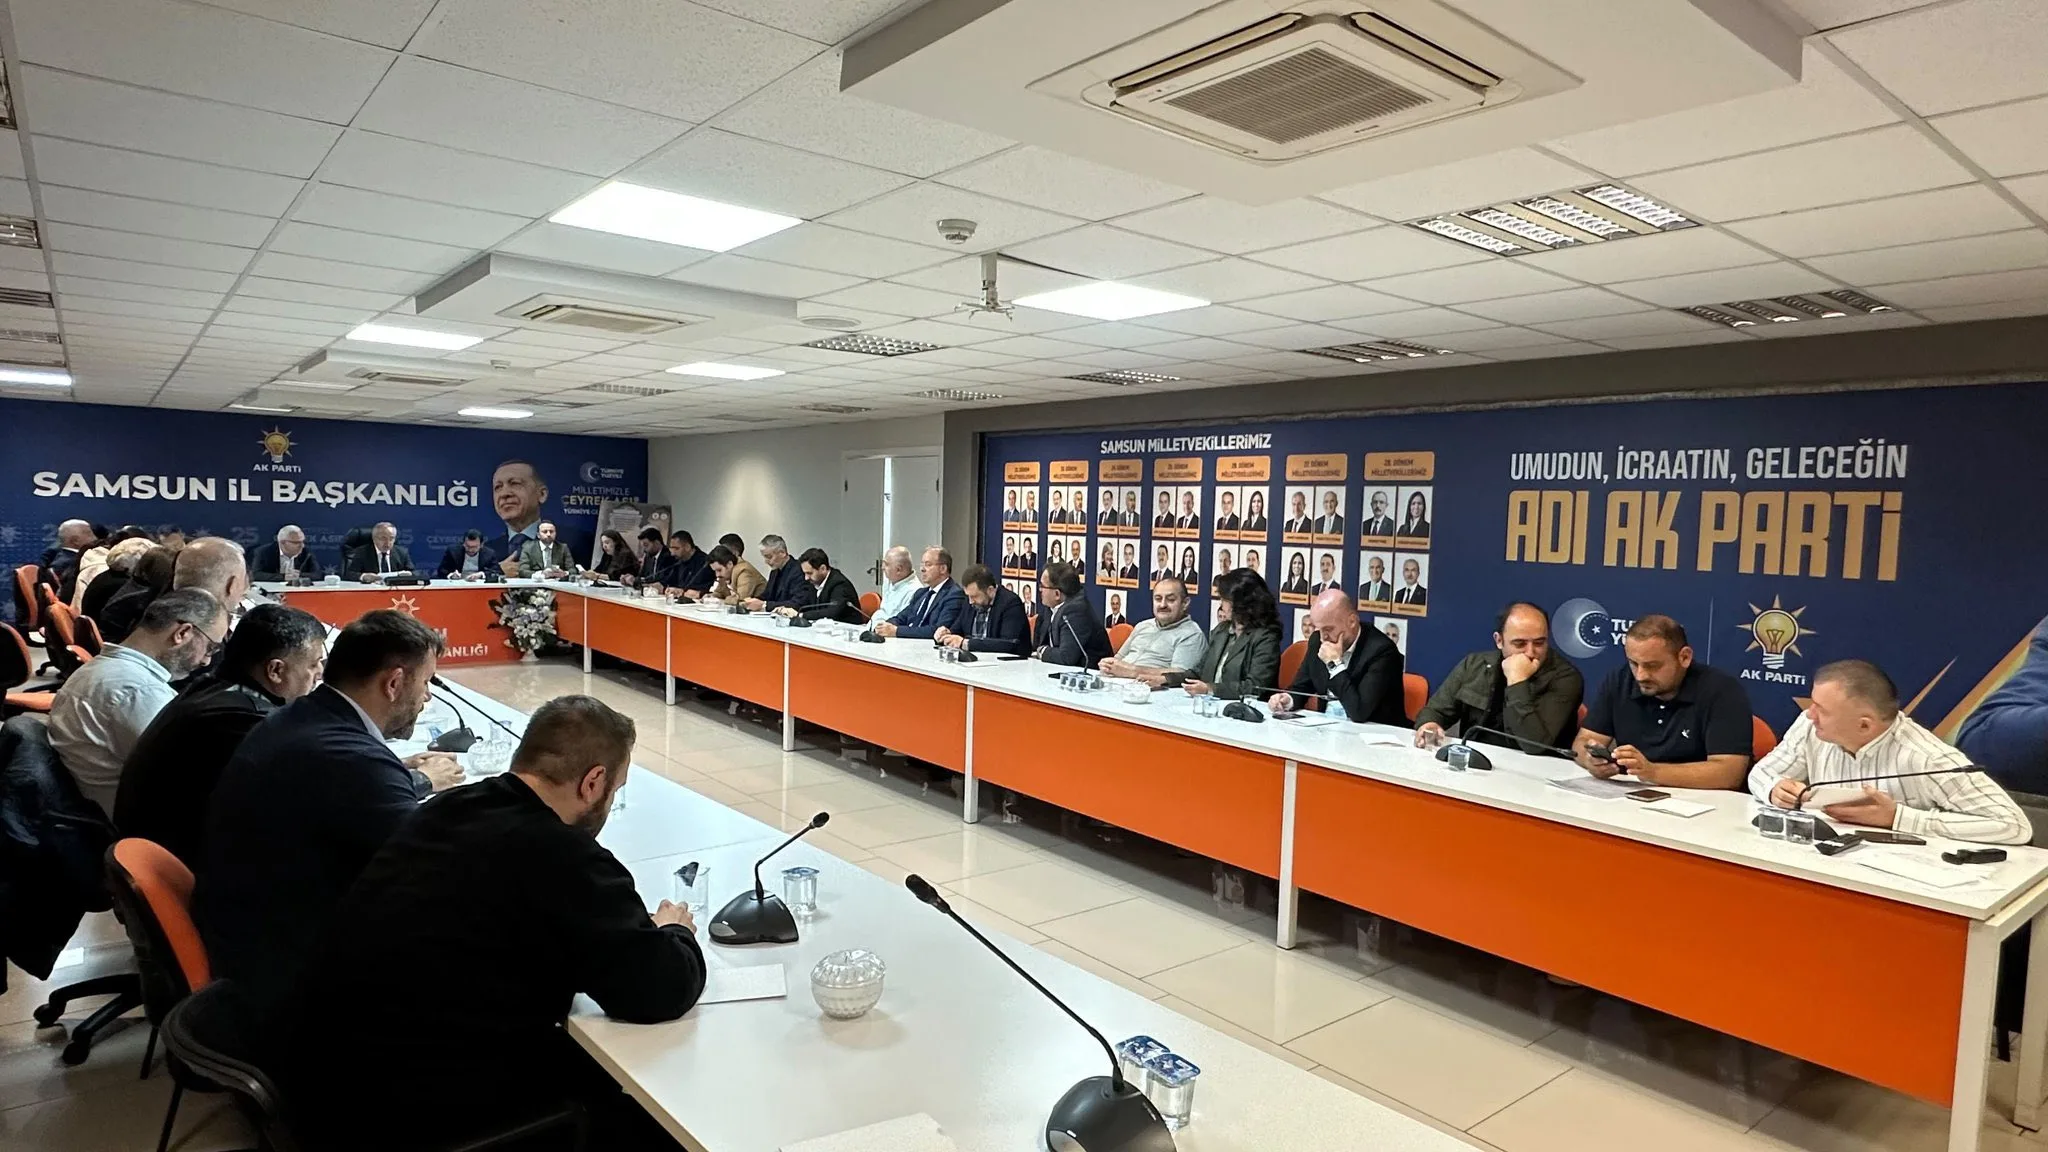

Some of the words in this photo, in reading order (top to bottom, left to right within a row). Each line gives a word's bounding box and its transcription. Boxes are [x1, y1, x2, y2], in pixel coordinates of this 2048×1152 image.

[1100, 439, 1145, 454] SAMSUN
[1148, 433, 1272, 453] MİLLETVEKİLLERİMİZ
[253, 463, 269, 472] AK
[1510, 451, 1609, 484] UMUDUN,
[1616, 445, 1737, 484] İCRAATIN,
[1746, 438, 1908, 479] GELECEĞİN
[33, 471, 216, 501] SAMSUN
[228, 478, 261, 502] İL
[272, 480, 478, 508] BAŞKANLIĞI
[1505, 490, 1590, 565] ADI
[1603, 490, 1682, 570] AK
[1696, 490, 1903, 582] PARTİ
[1740, 669, 1761, 681] AK
